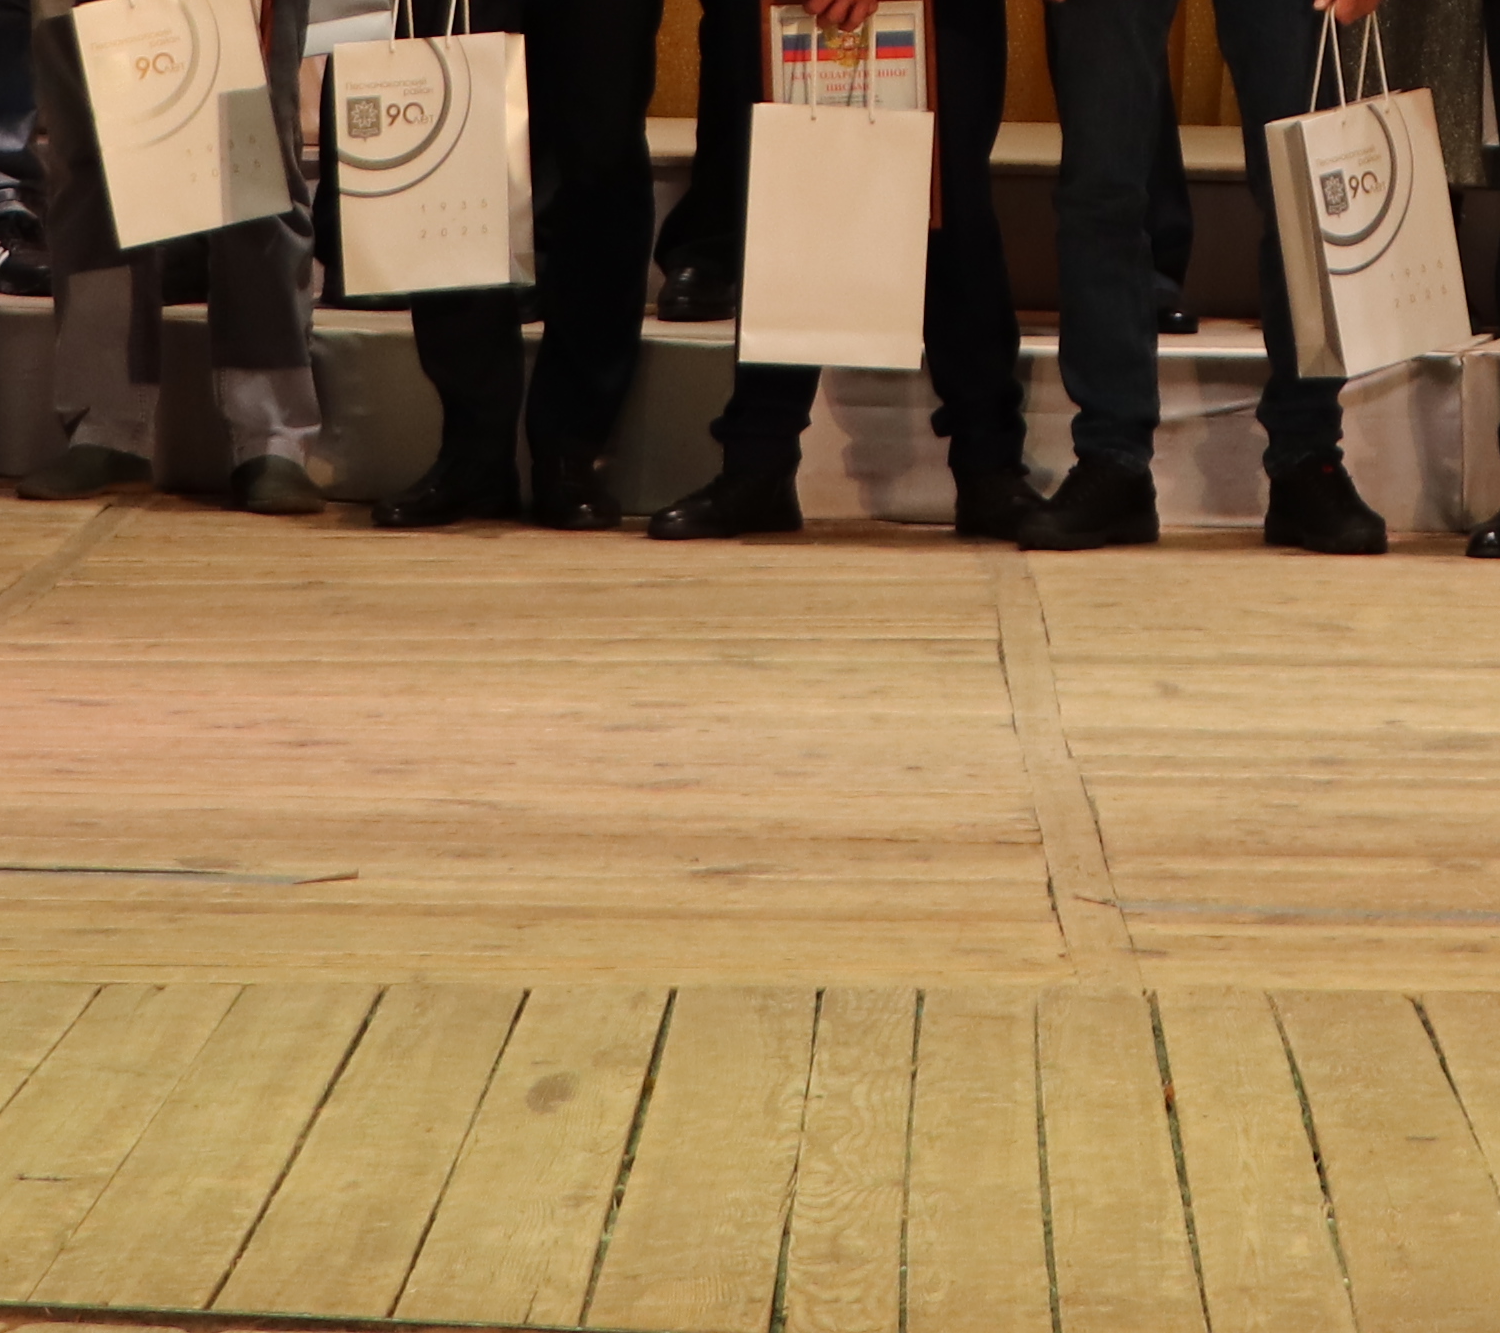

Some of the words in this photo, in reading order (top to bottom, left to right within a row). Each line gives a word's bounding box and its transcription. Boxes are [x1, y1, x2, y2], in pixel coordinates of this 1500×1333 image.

[135, 52, 175, 81] 90
[826, 82, 870, 92] ПИСЬМ
[386, 101, 425, 127] 90
[1348, 169, 1378, 199] 90
